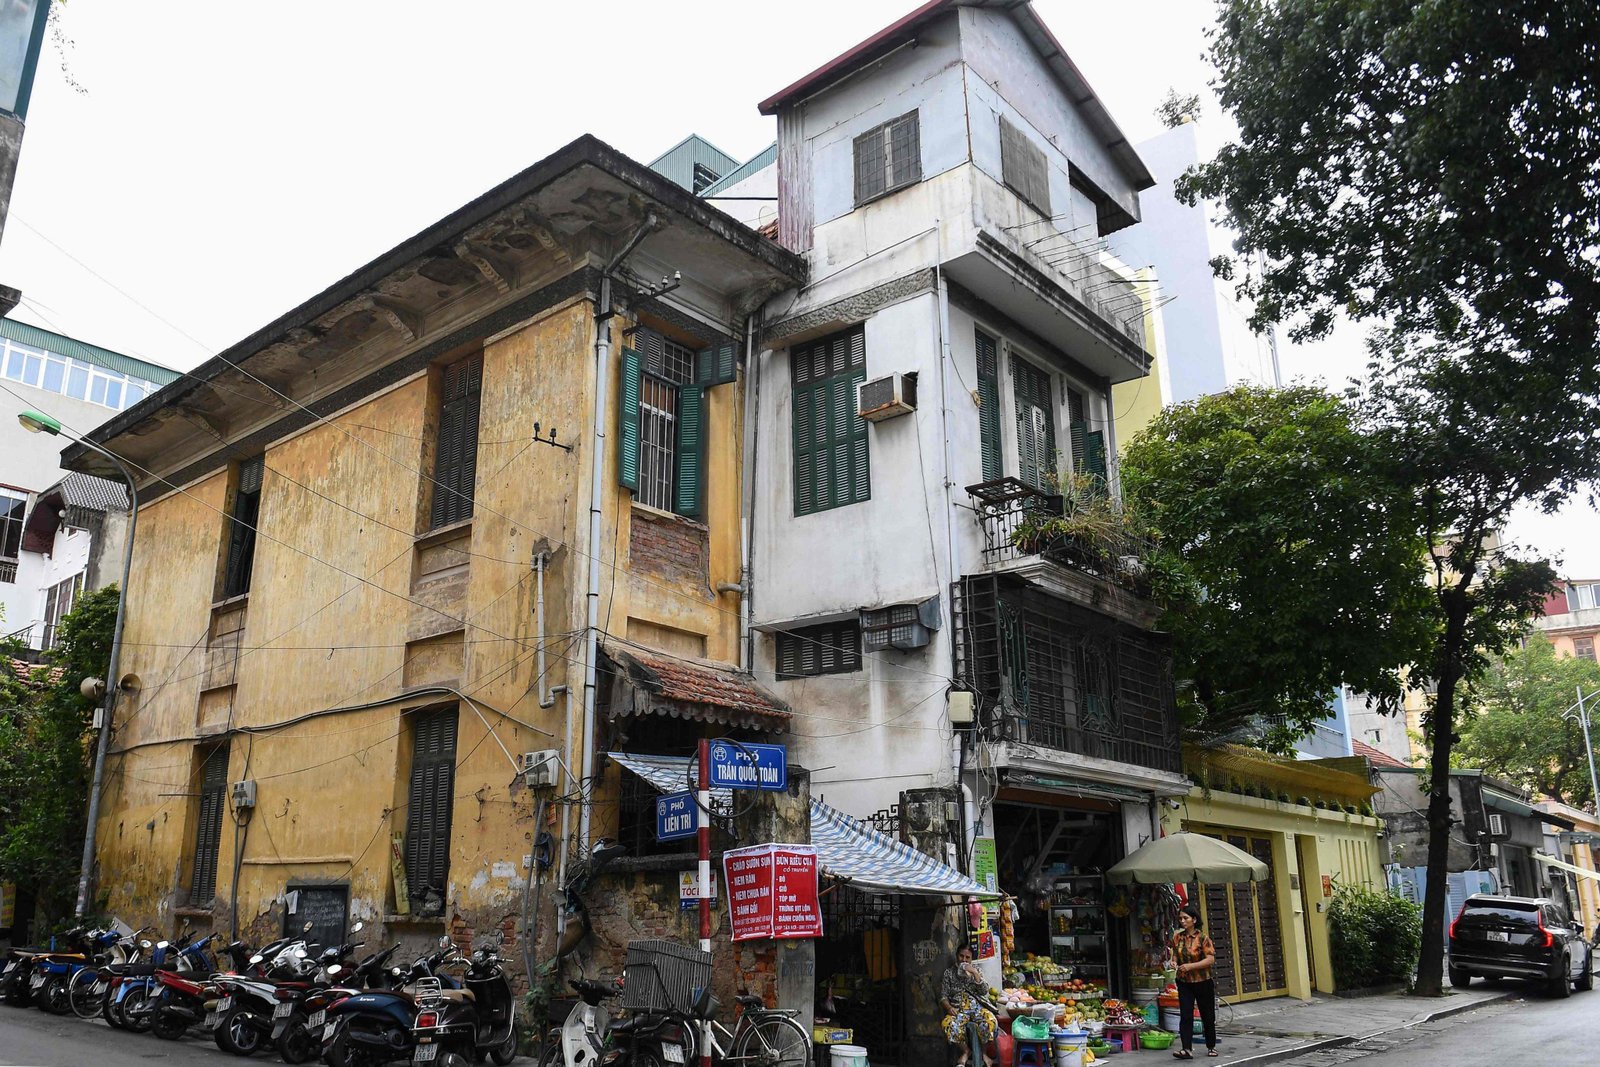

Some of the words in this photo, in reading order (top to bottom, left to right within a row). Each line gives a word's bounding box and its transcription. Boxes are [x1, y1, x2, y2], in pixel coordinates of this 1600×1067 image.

[735, 749, 760, 761] PHỐ
[717, 760, 737, 780] TRẦN
[738, 762, 758, 782] QUỐC
[759, 762, 778, 783] TOẢN
[670, 797, 685, 811] PHỐ
[664, 813, 680, 833] LIÊN
[680, 810, 692, 830] TRÌ
[776, 854, 789, 865] BÚN
[803, 857, 813, 866] CUA
[734, 875, 746, 886] NEM
[735, 890, 747, 901] NEM
